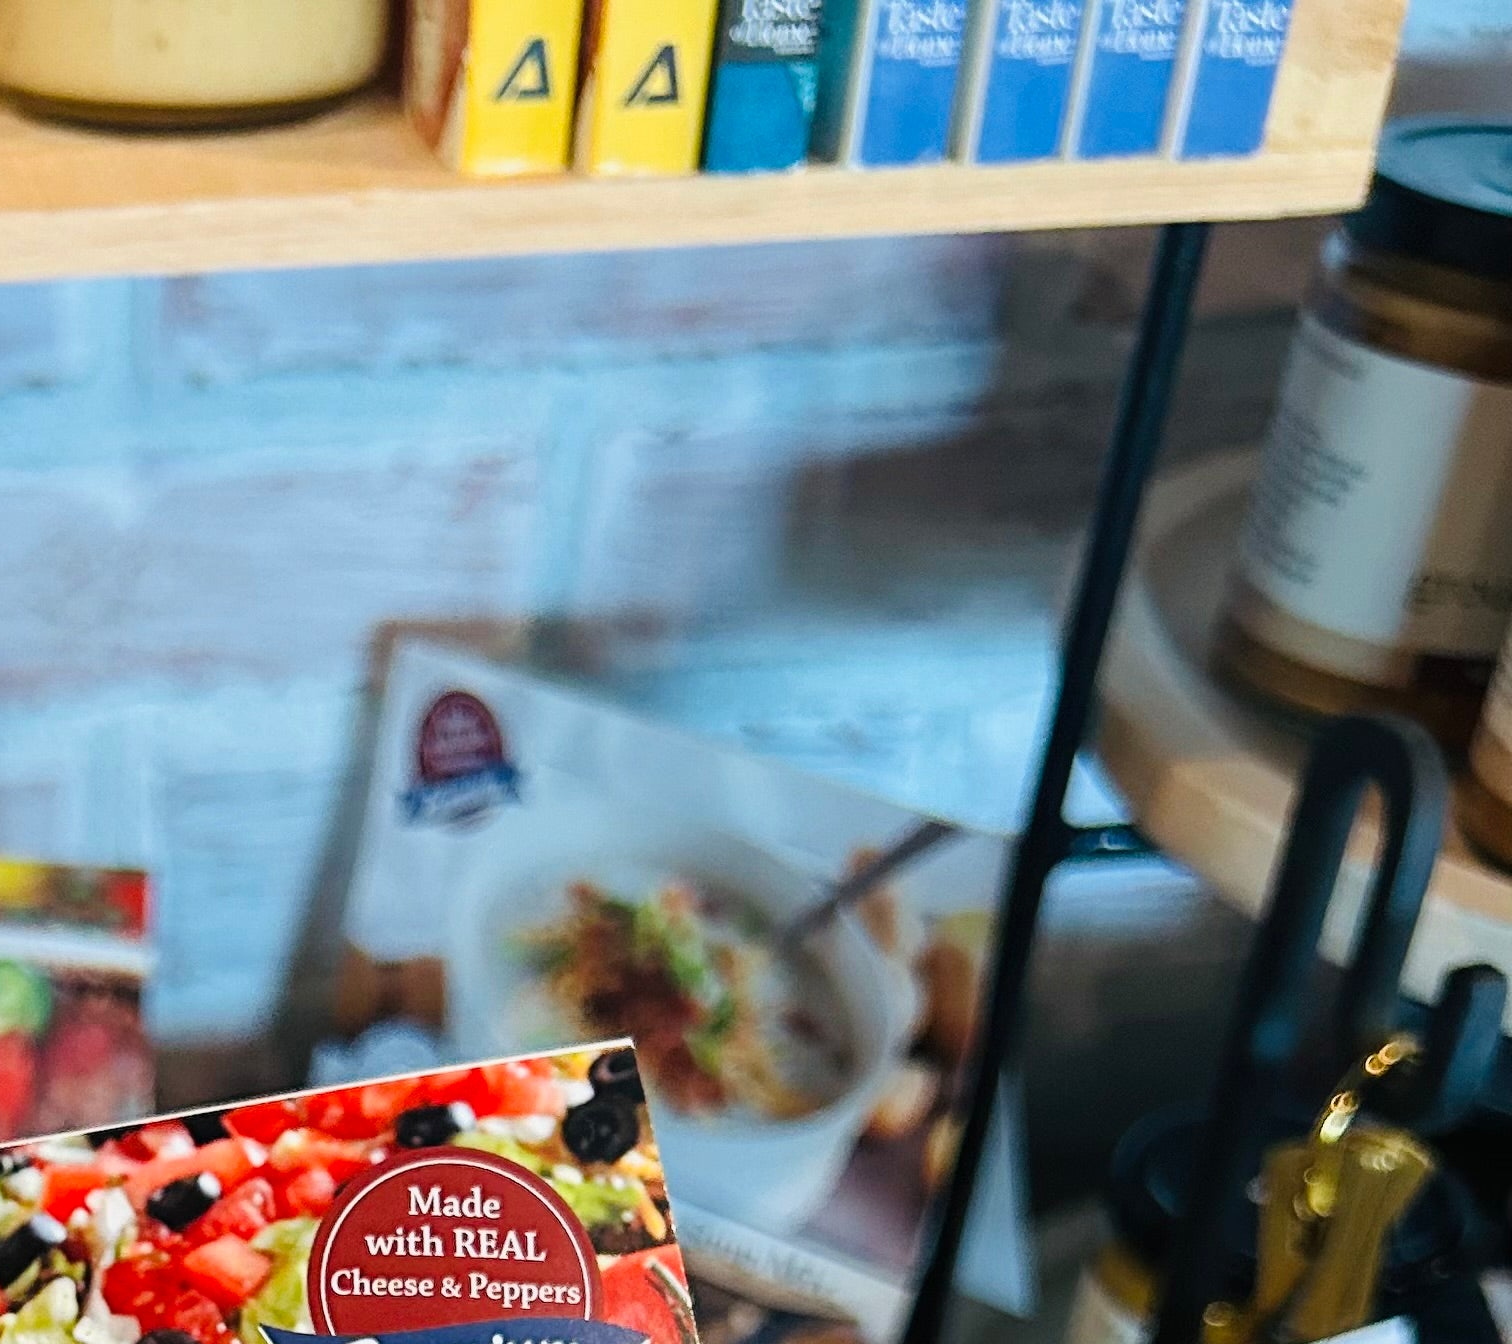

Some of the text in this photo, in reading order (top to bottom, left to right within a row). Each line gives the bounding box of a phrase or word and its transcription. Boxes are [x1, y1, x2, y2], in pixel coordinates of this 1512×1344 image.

[407, 1185, 501, 1219] Made
[364, 1227, 547, 1262] with REAL
[330, 1267, 581, 1310] Cheese & Peppers
